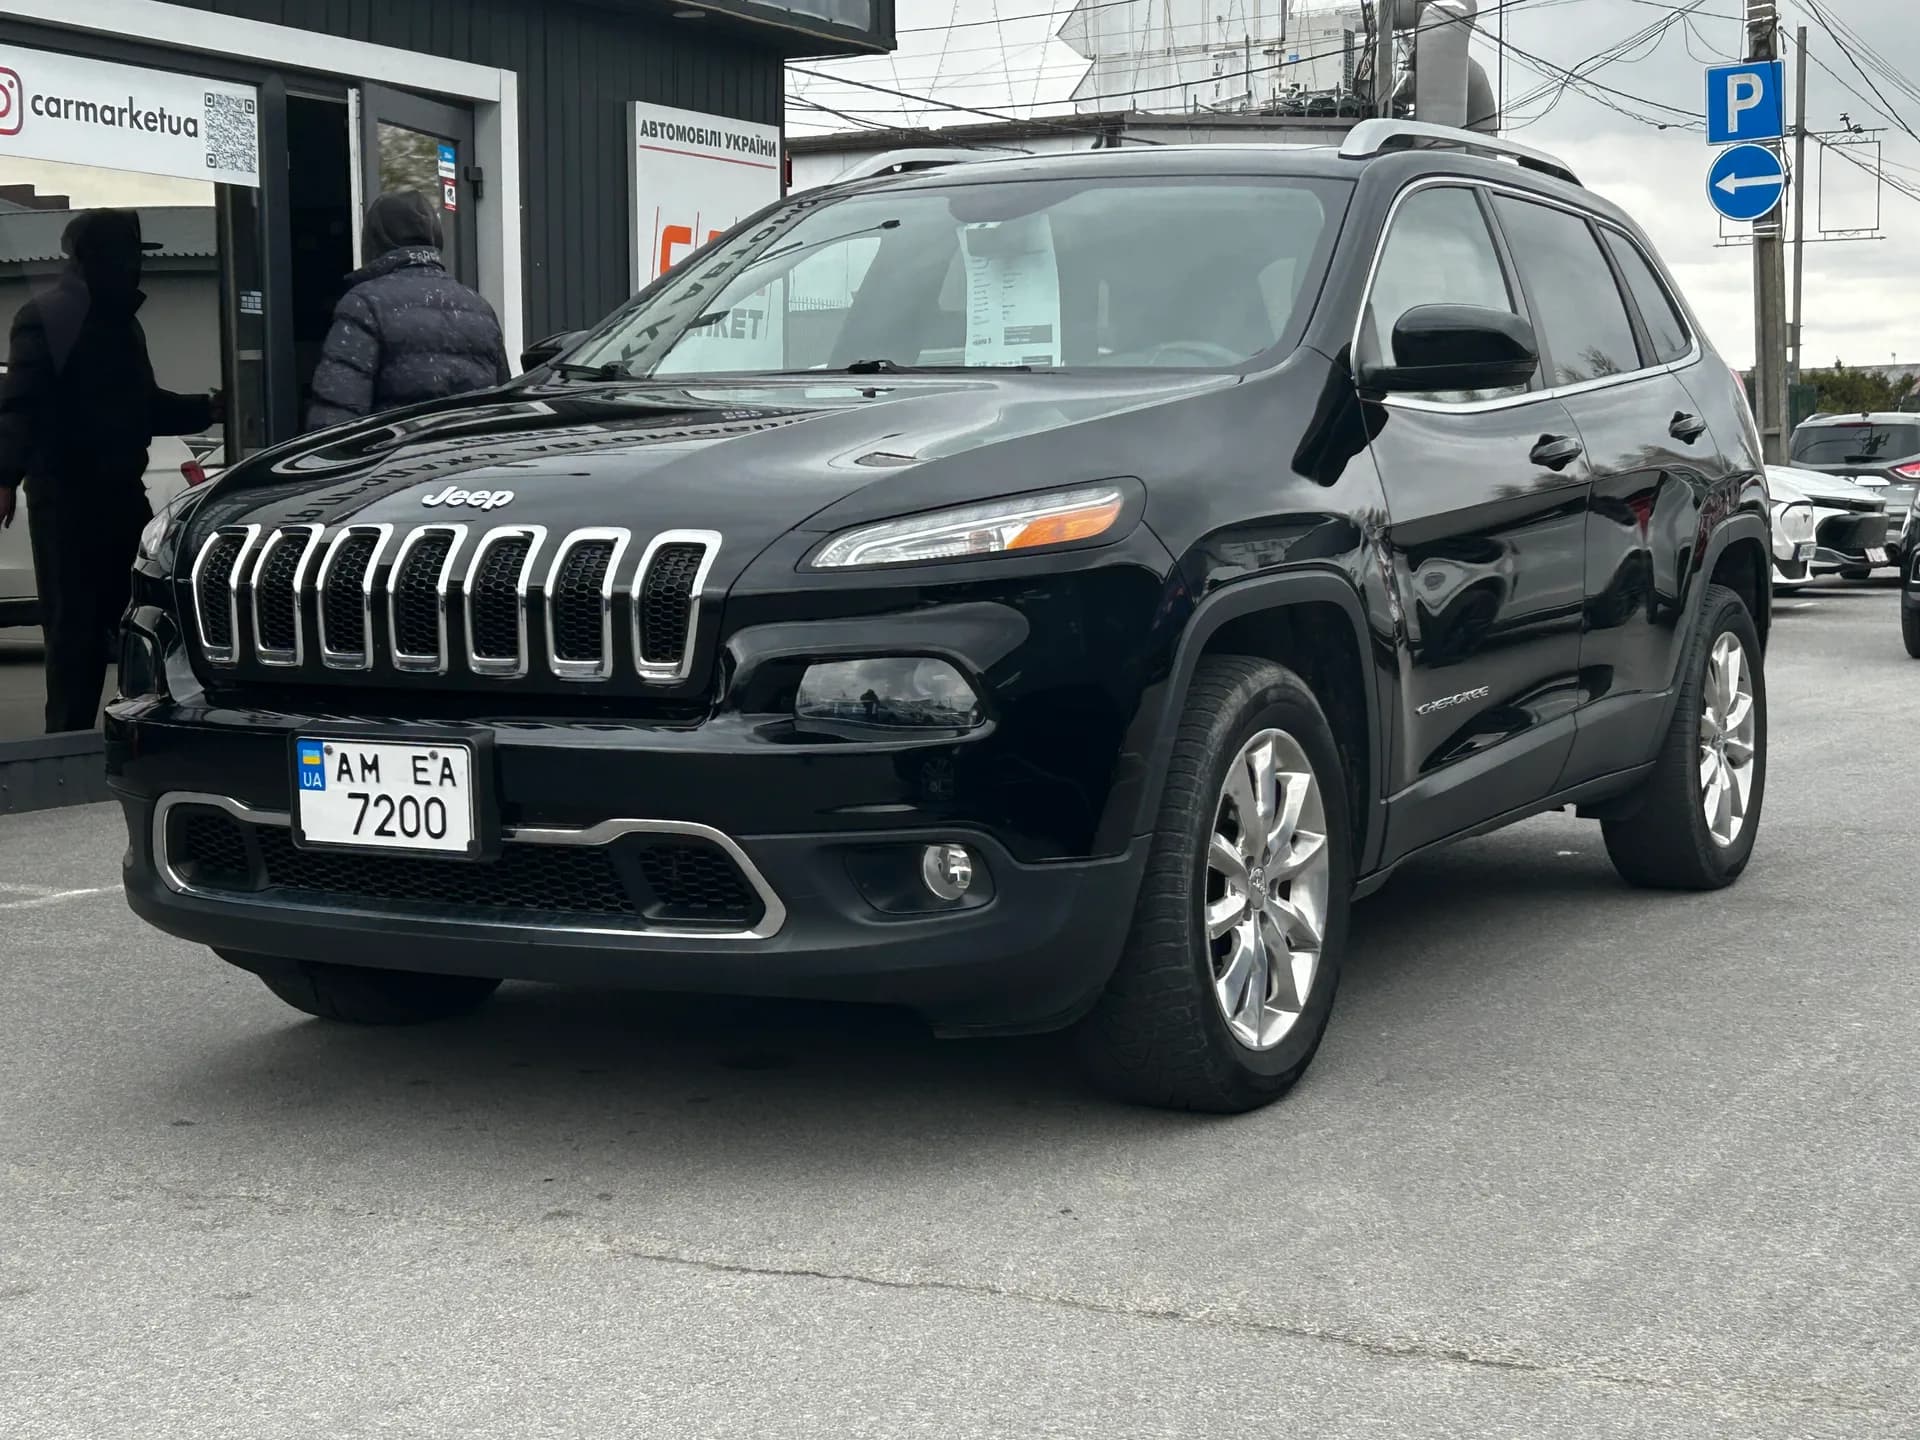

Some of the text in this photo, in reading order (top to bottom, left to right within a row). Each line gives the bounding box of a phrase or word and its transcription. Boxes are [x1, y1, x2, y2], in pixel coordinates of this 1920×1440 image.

[31, 94, 199, 138] carmarketua
[1727, 73, 1764, 133] P
[640, 119, 777, 158] АВТОМОБІЛІ УКРАЇНИ
[421, 485, 515, 512] Jeep
[303, 772, 322, 788] UA
[336, 752, 457, 787] AM EA
[347, 792, 447, 840] 7200
